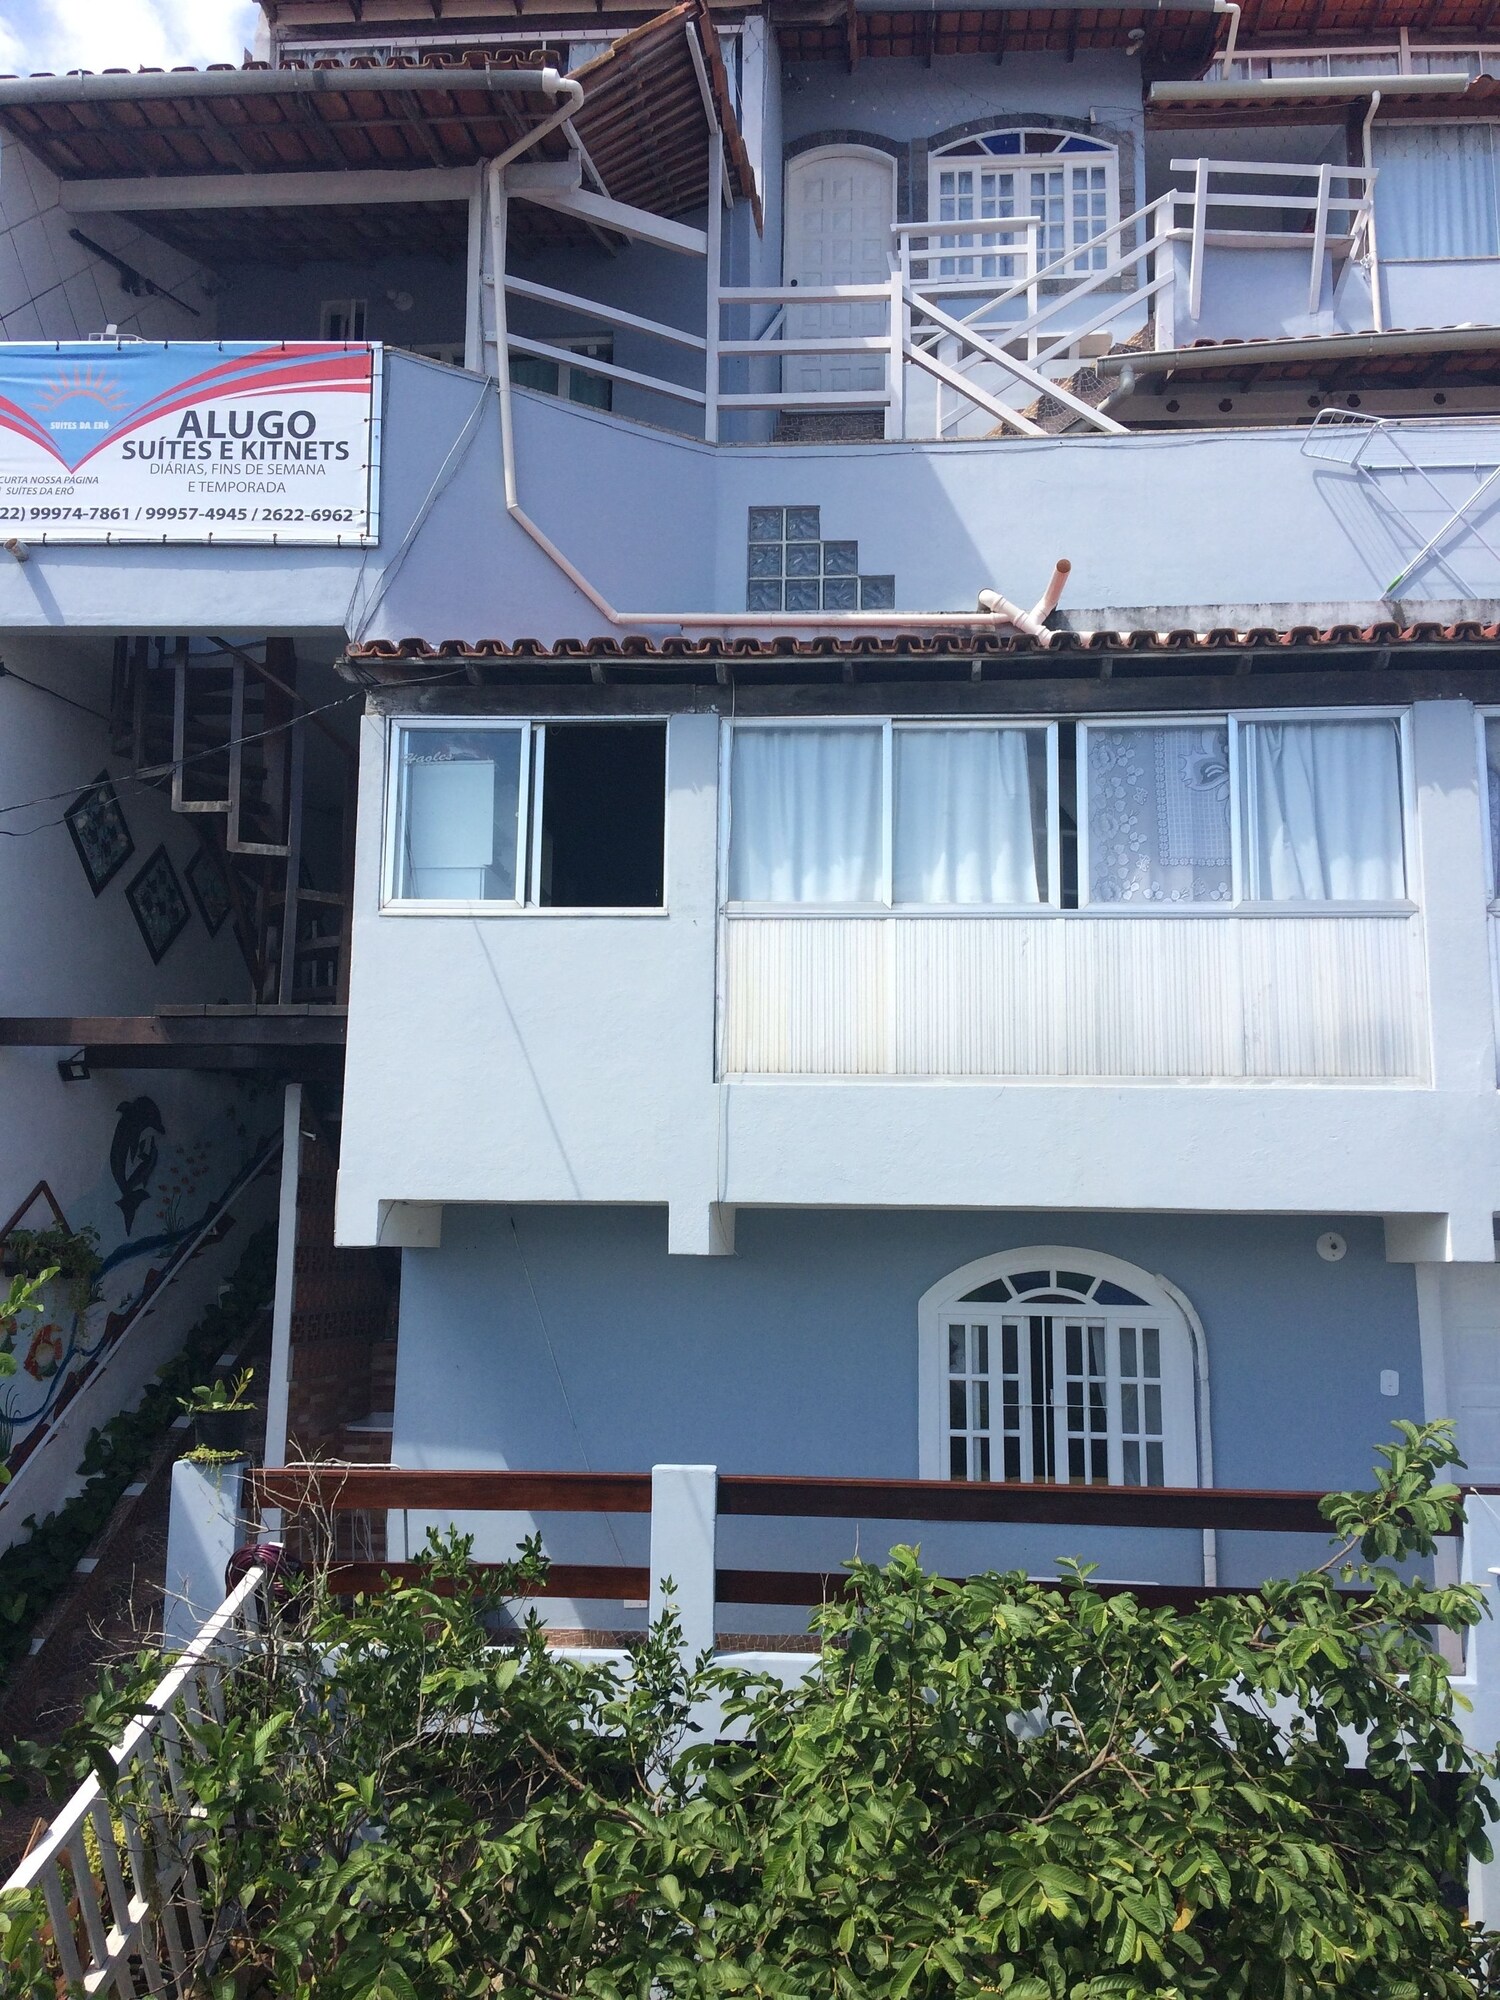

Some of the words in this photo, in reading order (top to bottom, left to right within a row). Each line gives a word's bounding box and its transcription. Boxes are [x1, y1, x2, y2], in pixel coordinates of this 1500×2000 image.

[79, 421, 91, 430] DA
[177, 410, 317, 439] ALUGO
[122, 436, 212, 460] SUÍTES
[220, 441, 234, 460] E
[241, 440, 350, 461] KITNETS
[150, 461, 208, 476] DIÁRIAS,
[211, 463, 241, 475] FINS
[245, 463, 263, 475] DE
[267, 463, 326, 476] SEMANA
[30, 475, 62, 484] NOSSA
[63, 474, 99, 484] PÁGINA
[6, 485, 37, 495] SUÍTES
[39, 486, 53, 495] DA
[188, 481, 195, 493] E
[199, 481, 286, 493] TEMPORADA
[30, 507, 130, 521] 99974-7861
[135, 507, 143, 521] /
[145, 507, 247, 521] 99957-4945
[251, 507, 259, 521] /
[262, 508, 353, 522] 2622-6962
